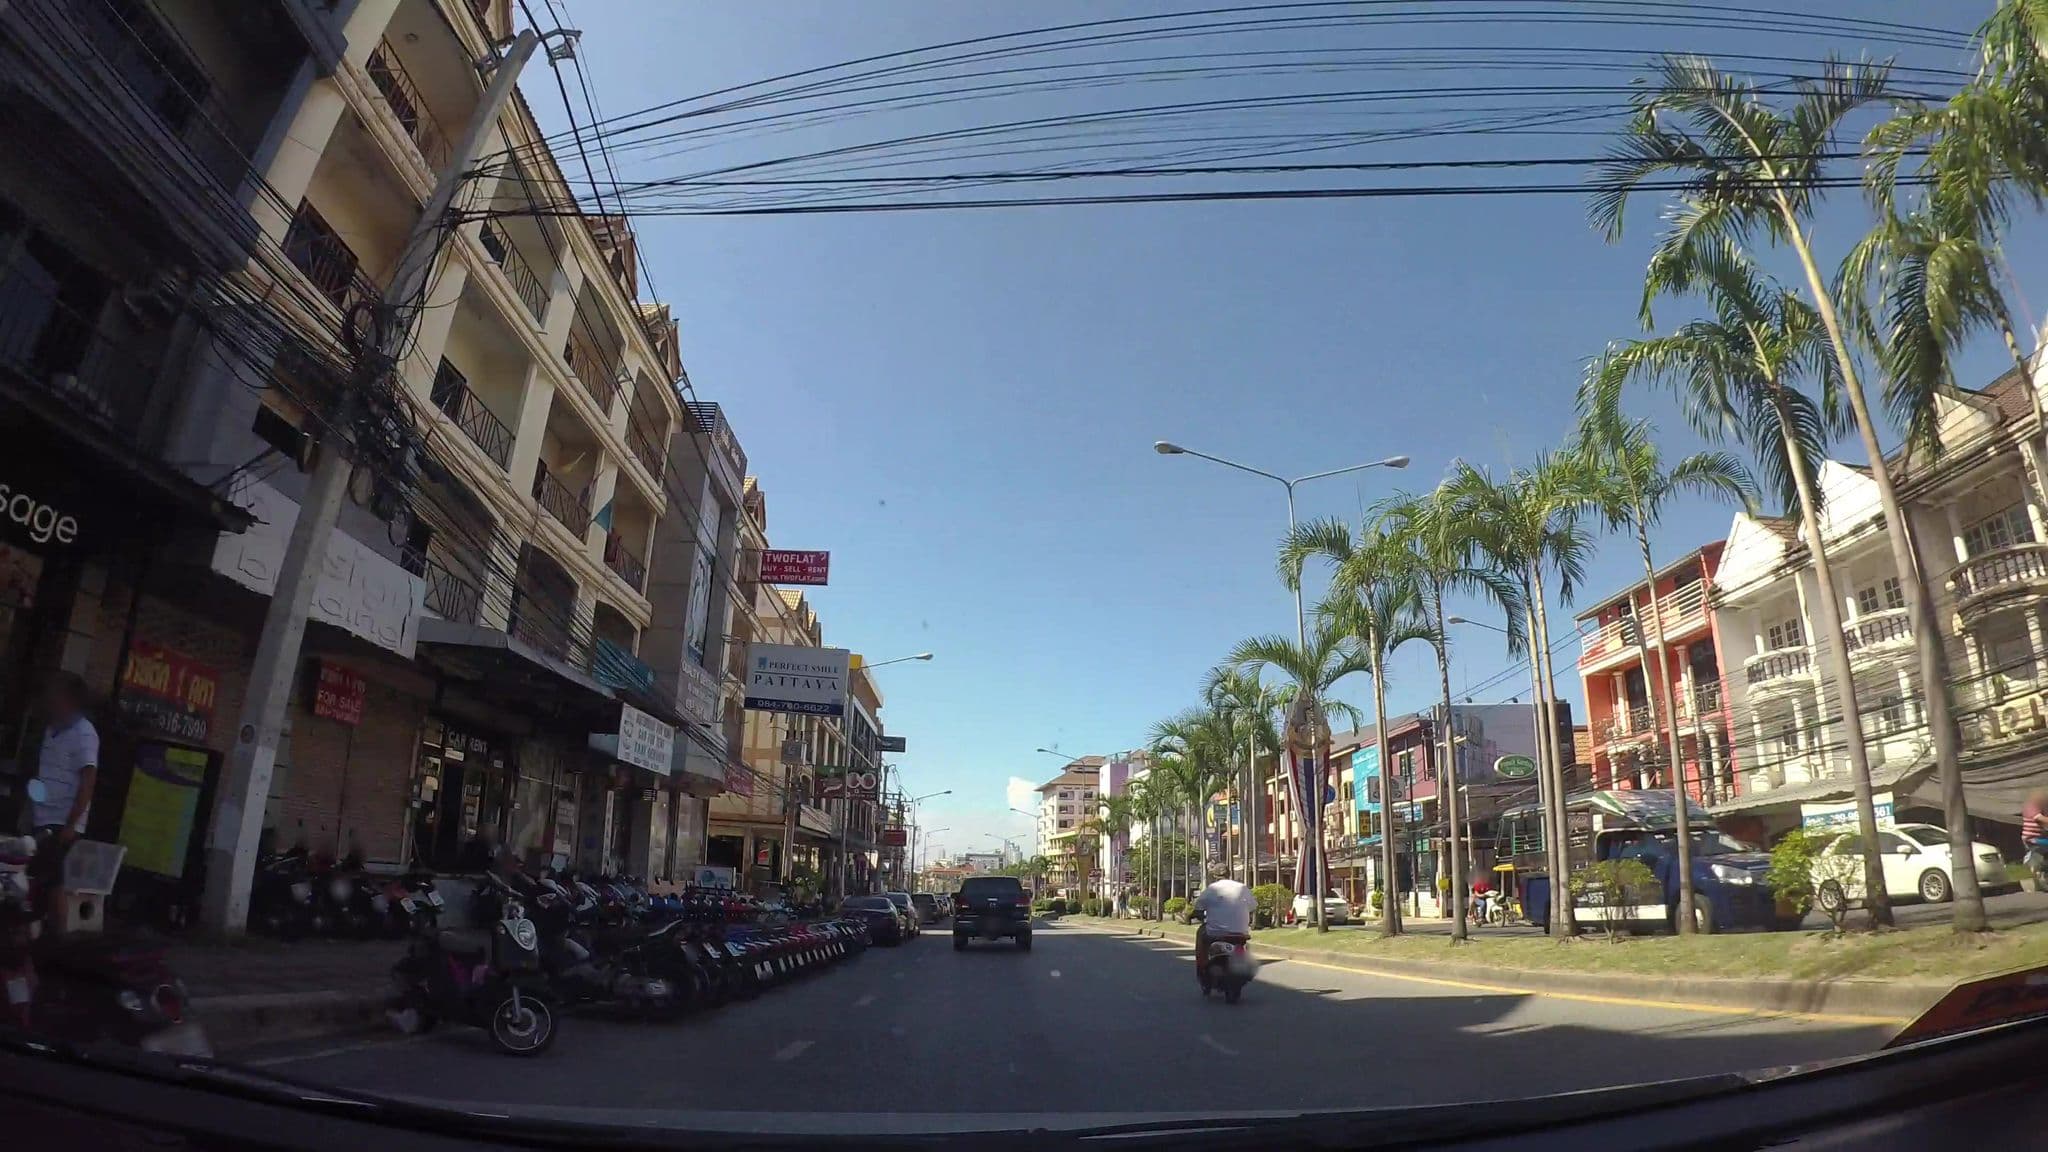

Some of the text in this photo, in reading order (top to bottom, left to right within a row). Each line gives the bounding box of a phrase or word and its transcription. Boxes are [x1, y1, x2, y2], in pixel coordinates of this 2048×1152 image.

[765, 553, 816, 564] TWOFLAT
[783, 565, 801, 573] SELL
[768, 662, 840, 674] PERFECT SMILE
[754, 674, 838, 691] PATTAYA
